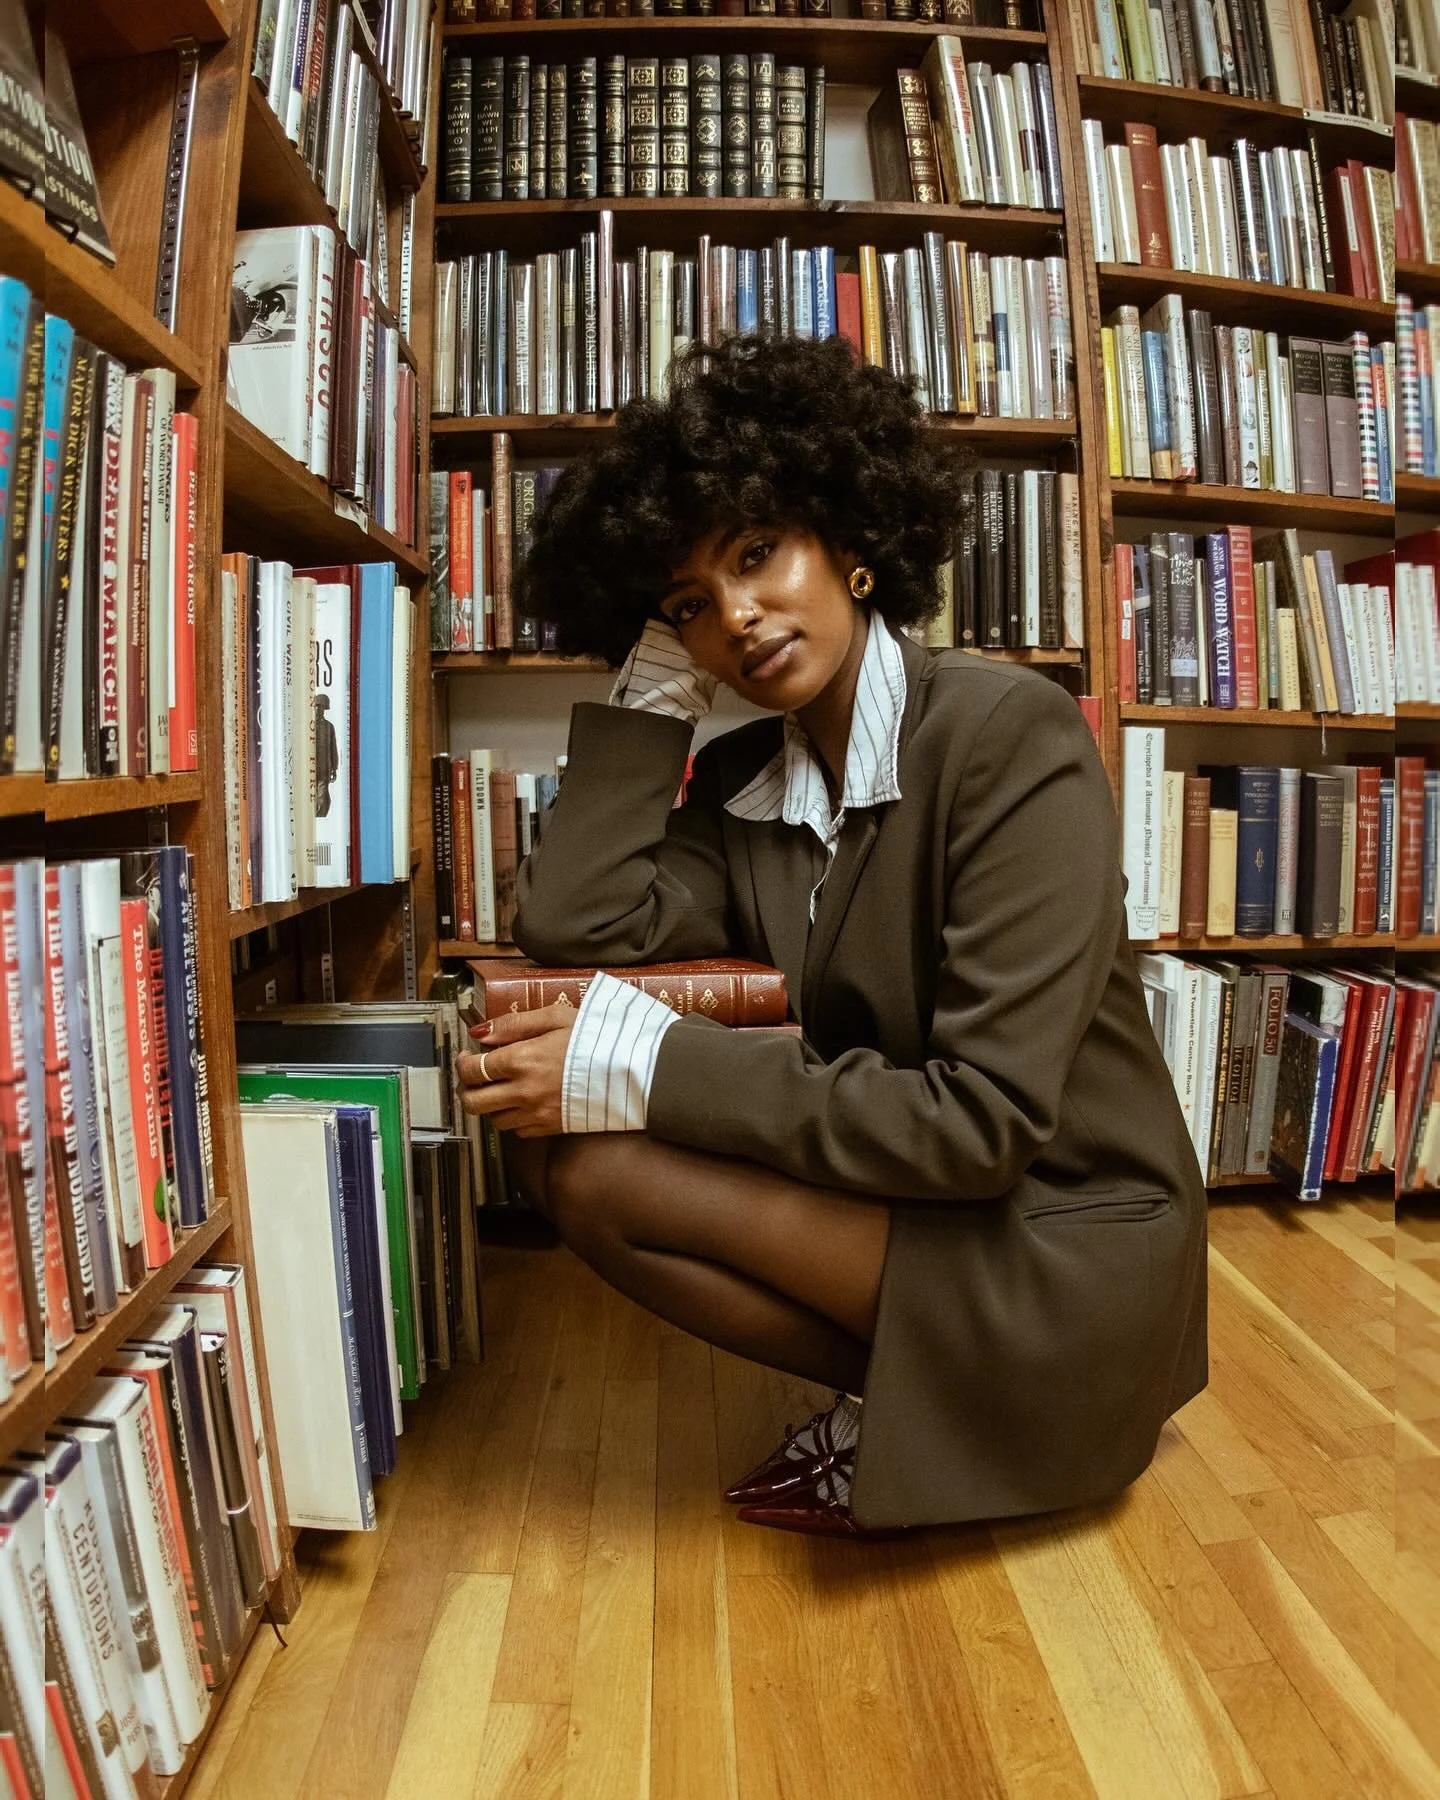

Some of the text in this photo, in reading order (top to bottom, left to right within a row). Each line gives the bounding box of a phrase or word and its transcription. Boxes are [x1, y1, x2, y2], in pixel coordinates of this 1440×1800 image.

[448, 112, 470, 120] DAWN
[448, 127, 469, 135] SLEPT
[454, 104, 463, 112] AT
[478, 111, 500, 120] DAWN
[482, 119, 493, 127] WE
[45, 175, 98, 223] STINGS
[818, 280, 829, 309] Gods
[935, 289, 947, 338] HUMANITY
[319, 272, 335, 412] FIASCO
[516, 301, 529, 386] AMERICAN DAWN
[56, 357, 89, 562] MAJOR DICK WINTERS
[104, 437, 121, 558] DEATH
[496, 499, 508, 536] Mankind
[1071, 491, 1079, 526] TAKING
[186, 470, 198, 625] PEARL HARBOR
[103, 576, 120, 722] MARCH
[1213, 577, 1232, 677] WORD WATCH
[1144, 733, 1154, 778] Encyclopedia
[475, 768, 487, 811] PILTDOWN
[46, 904, 64, 963] THE
[133, 924, 144, 972] The
[50, 965, 73, 1062] DESERT
[135, 976, 151, 1057] March
[1188, 996, 1198, 1039] Twentieth
[1266, 988, 1282, 1036] FOLIO
[143, 1088, 160, 1160] Tunis
[200, 1101, 214, 1168] MOSIER
[67, 1160, 96, 1296] NORMANDY
[73, 1521, 116, 1662] CENTURIONS
